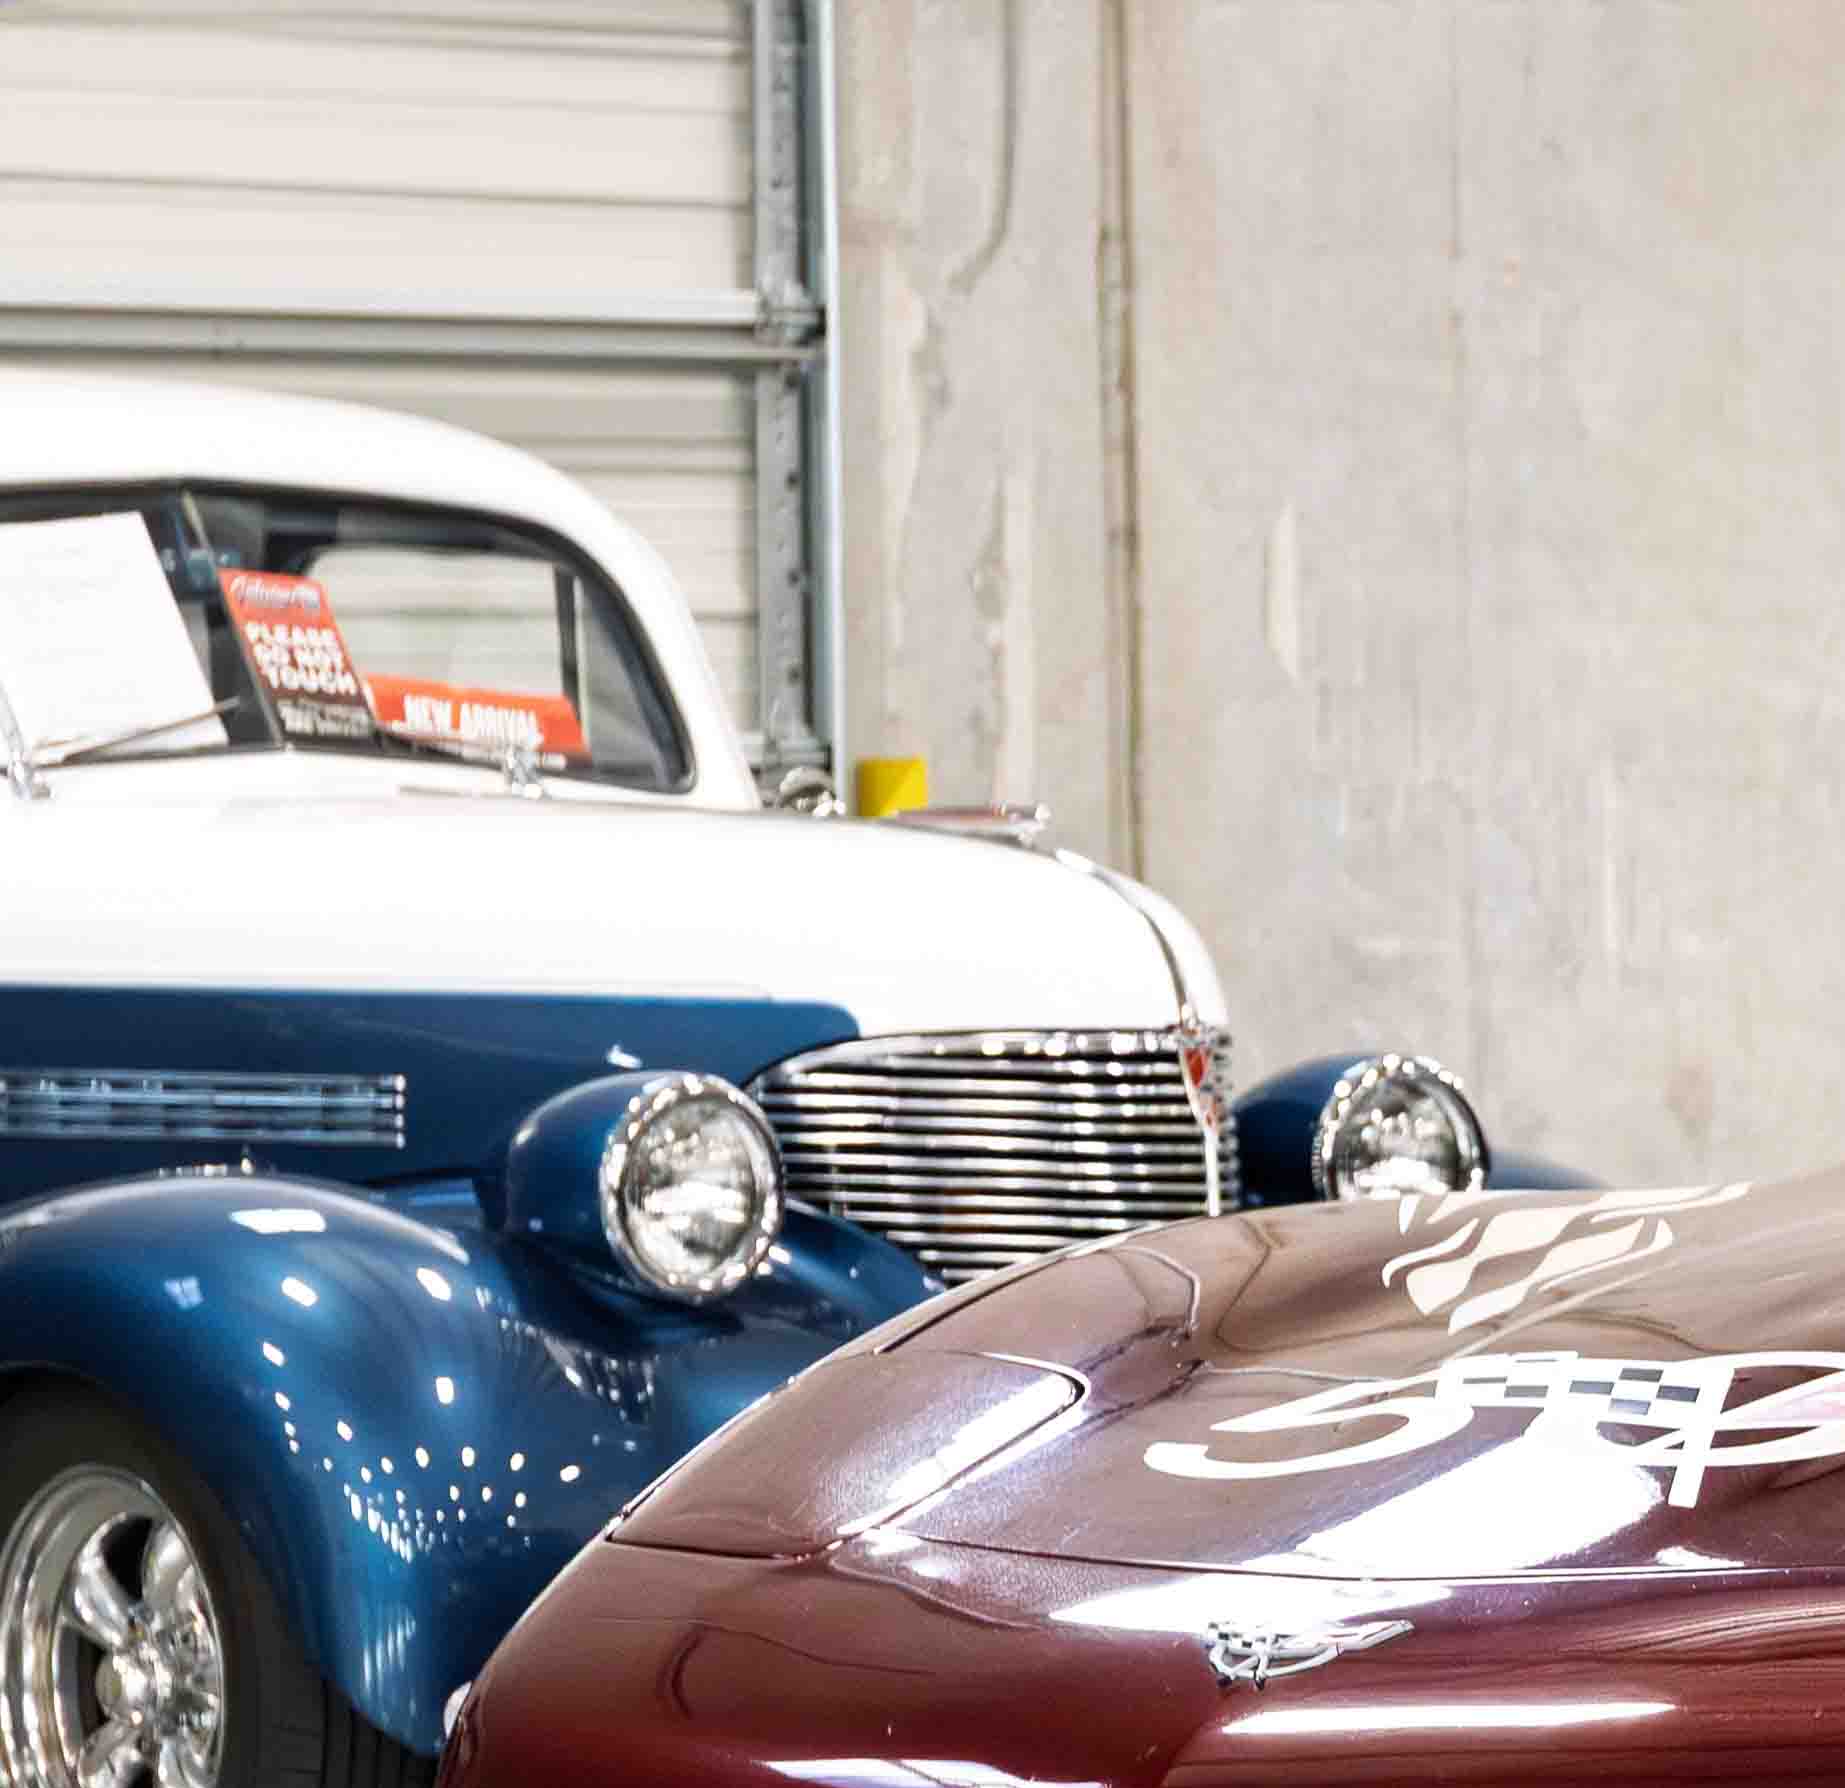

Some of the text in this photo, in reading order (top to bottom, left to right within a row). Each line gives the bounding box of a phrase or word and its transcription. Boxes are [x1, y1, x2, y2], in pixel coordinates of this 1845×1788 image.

[245, 620, 338, 649] PLEASE
[263, 666, 357, 695] TOUCH
[404, 693, 454, 736] NEW
